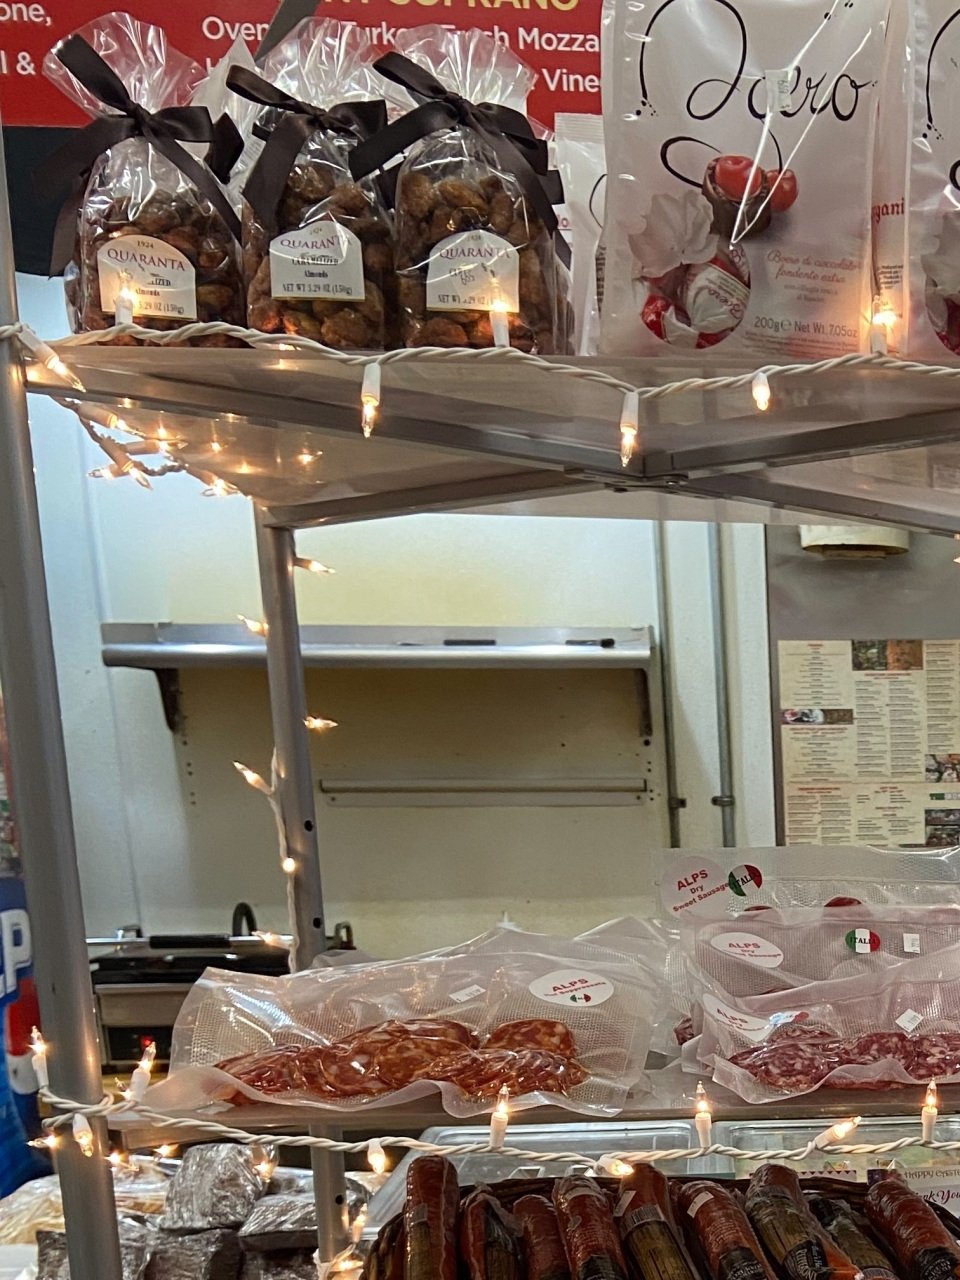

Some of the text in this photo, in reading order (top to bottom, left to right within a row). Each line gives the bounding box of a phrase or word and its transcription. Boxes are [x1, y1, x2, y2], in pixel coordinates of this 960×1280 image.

[107, 248, 186, 272] QUARANTA
[677, 869, 709, 890] ALPS
[690, 884, 704, 895] Dry
[552, 978, 589, 993] ALPS
